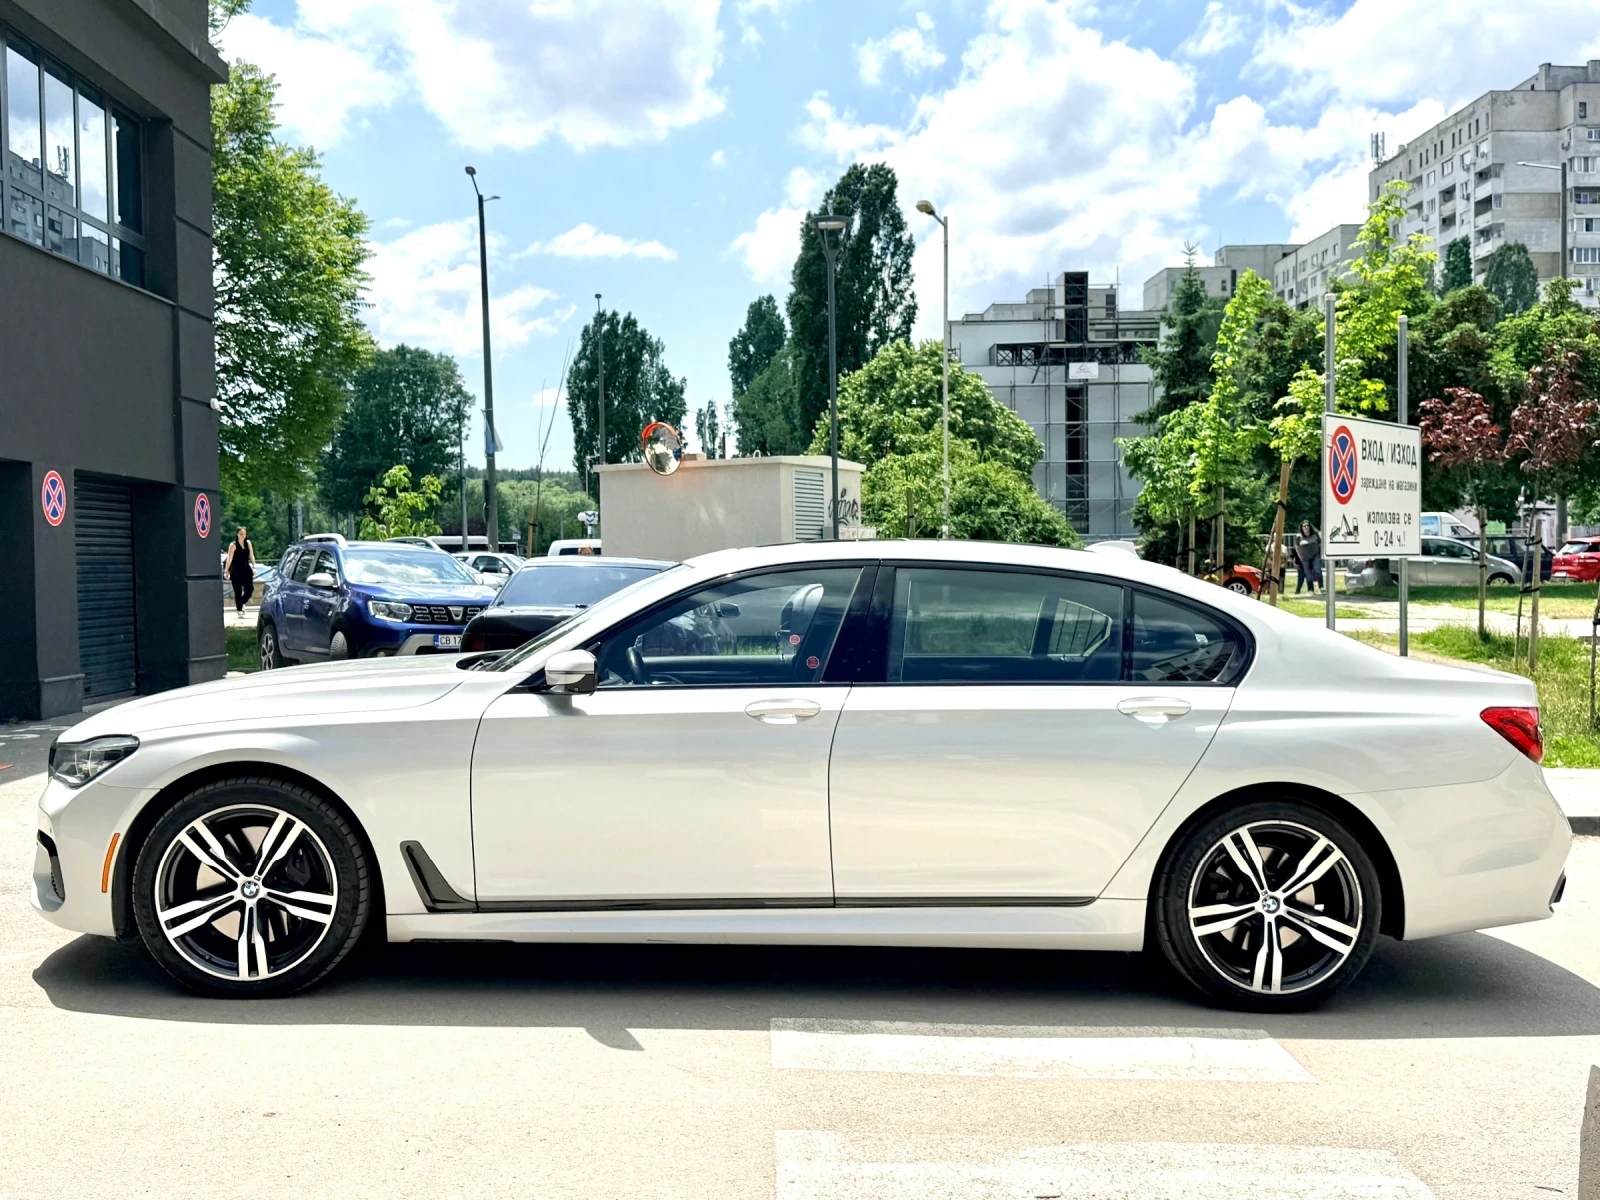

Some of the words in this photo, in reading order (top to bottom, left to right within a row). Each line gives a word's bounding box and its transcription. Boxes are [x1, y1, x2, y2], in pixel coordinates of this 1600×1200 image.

[1361, 438, 1384, 467] ВХОД
[1390, 442, 1417, 470] ИЗХОД
[1388, 479, 1395, 491] на
[1366, 511, 1401, 525] използва
[1403, 512, 1412, 525] се
[1373, 529, 1394, 547] 0-24
